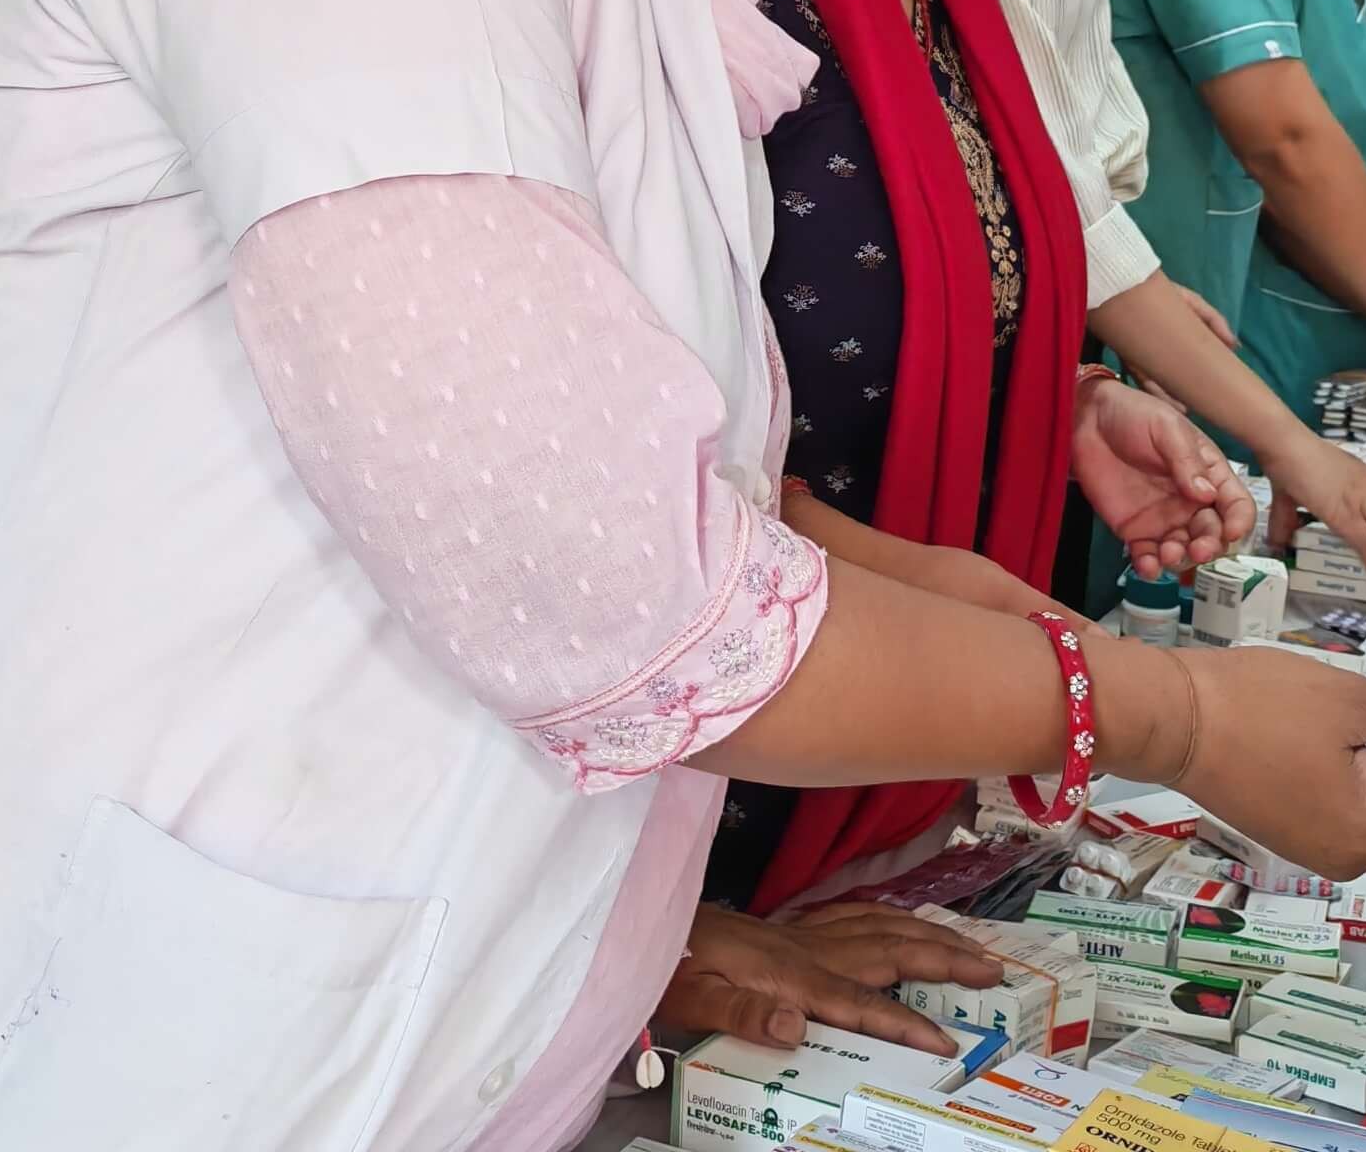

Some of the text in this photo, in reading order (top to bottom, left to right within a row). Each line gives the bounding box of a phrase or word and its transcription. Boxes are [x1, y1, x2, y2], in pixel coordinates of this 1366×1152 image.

[800, 1040, 870, 1062] AFE-500
[687, 1088, 747, 1119] Levofloxacin
[686, 1106, 785, 1144] LEVOSAFE-500
[1096, 1112, 1162, 1146] 500 mg
[1104, 1104, 1186, 1141] Ornidazole
